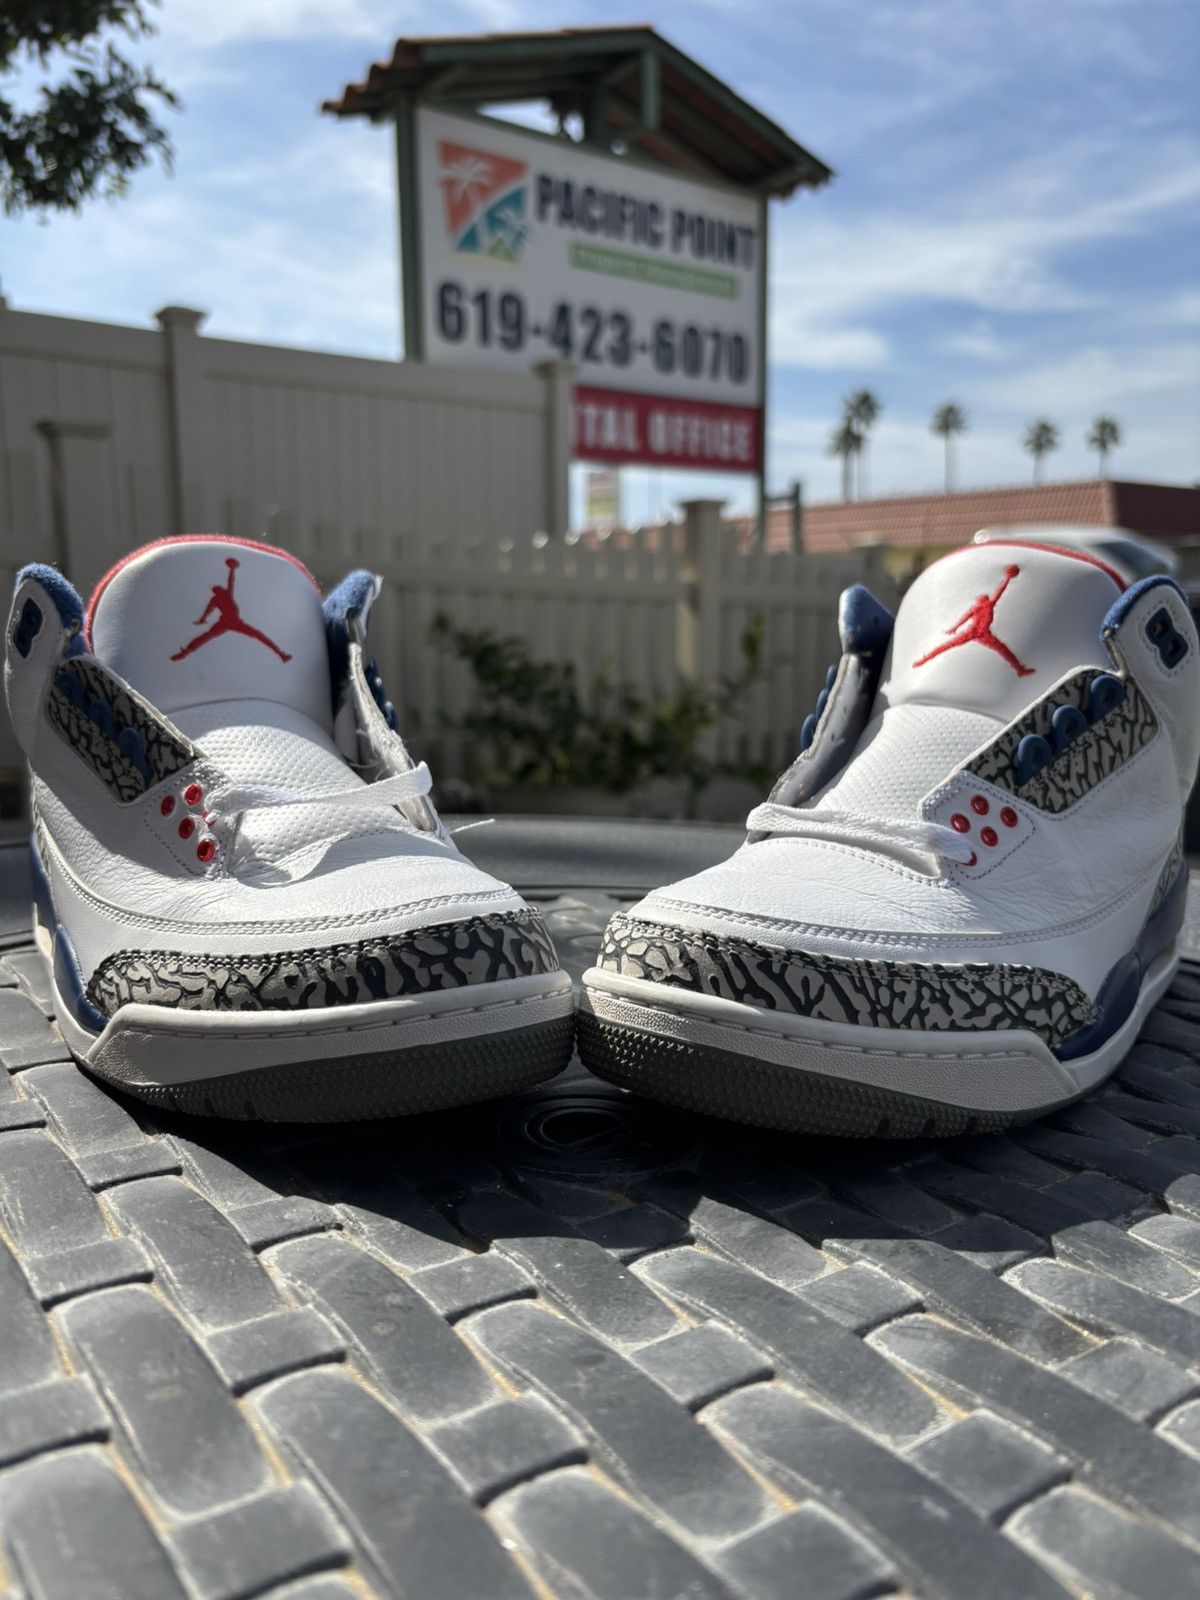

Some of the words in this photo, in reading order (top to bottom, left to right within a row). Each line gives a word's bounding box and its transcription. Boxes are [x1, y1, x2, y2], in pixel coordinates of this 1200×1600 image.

[536, 173, 663, 248] PACIFIC
[672, 209, 757, 269] POINT
[438, 281, 749, 384] 619-423-6070
[573, 402, 641, 452] TAL
[649, 409, 753, 462] OFFICE
